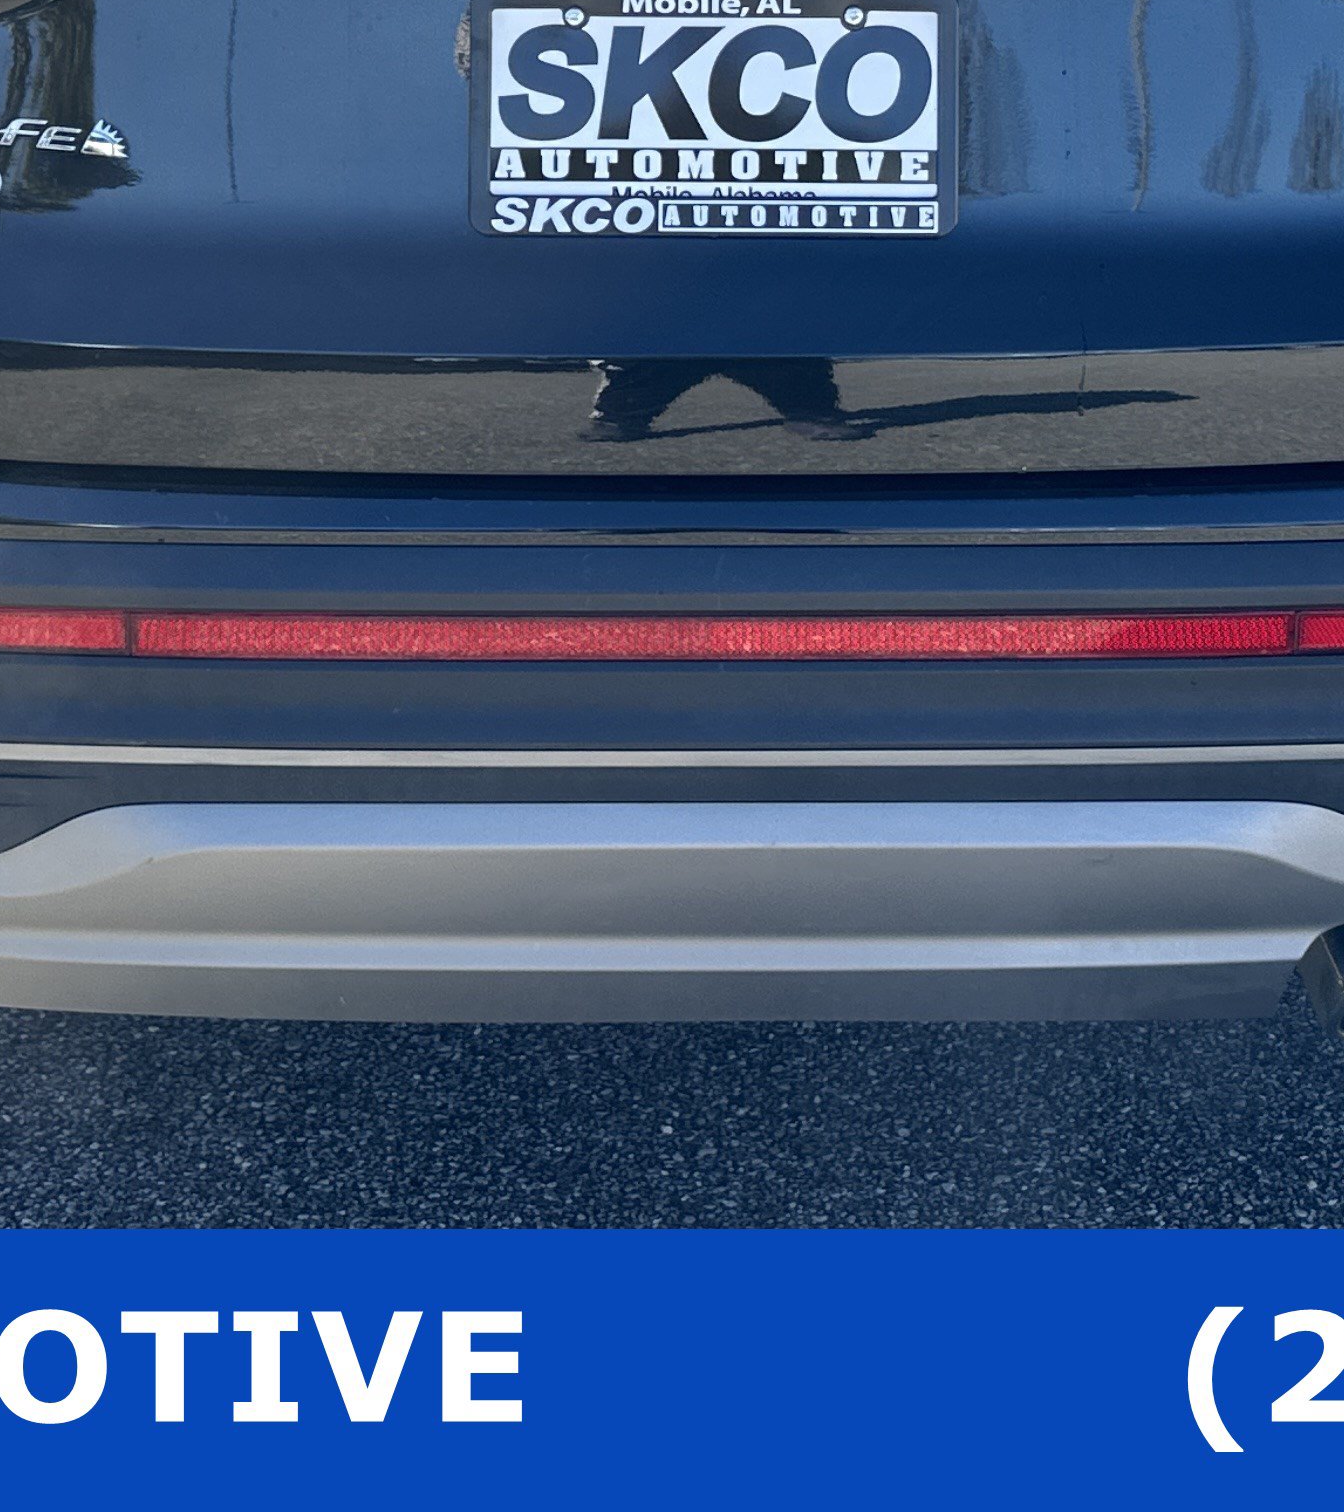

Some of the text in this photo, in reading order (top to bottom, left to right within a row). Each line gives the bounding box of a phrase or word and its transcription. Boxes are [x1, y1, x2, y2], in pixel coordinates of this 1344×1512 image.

[498, 24, 933, 144] SKCO
[494, 148, 931, 181] AUTOMOTIVE
[490, 196, 936, 234] SKCO AUTOMOTIVE
